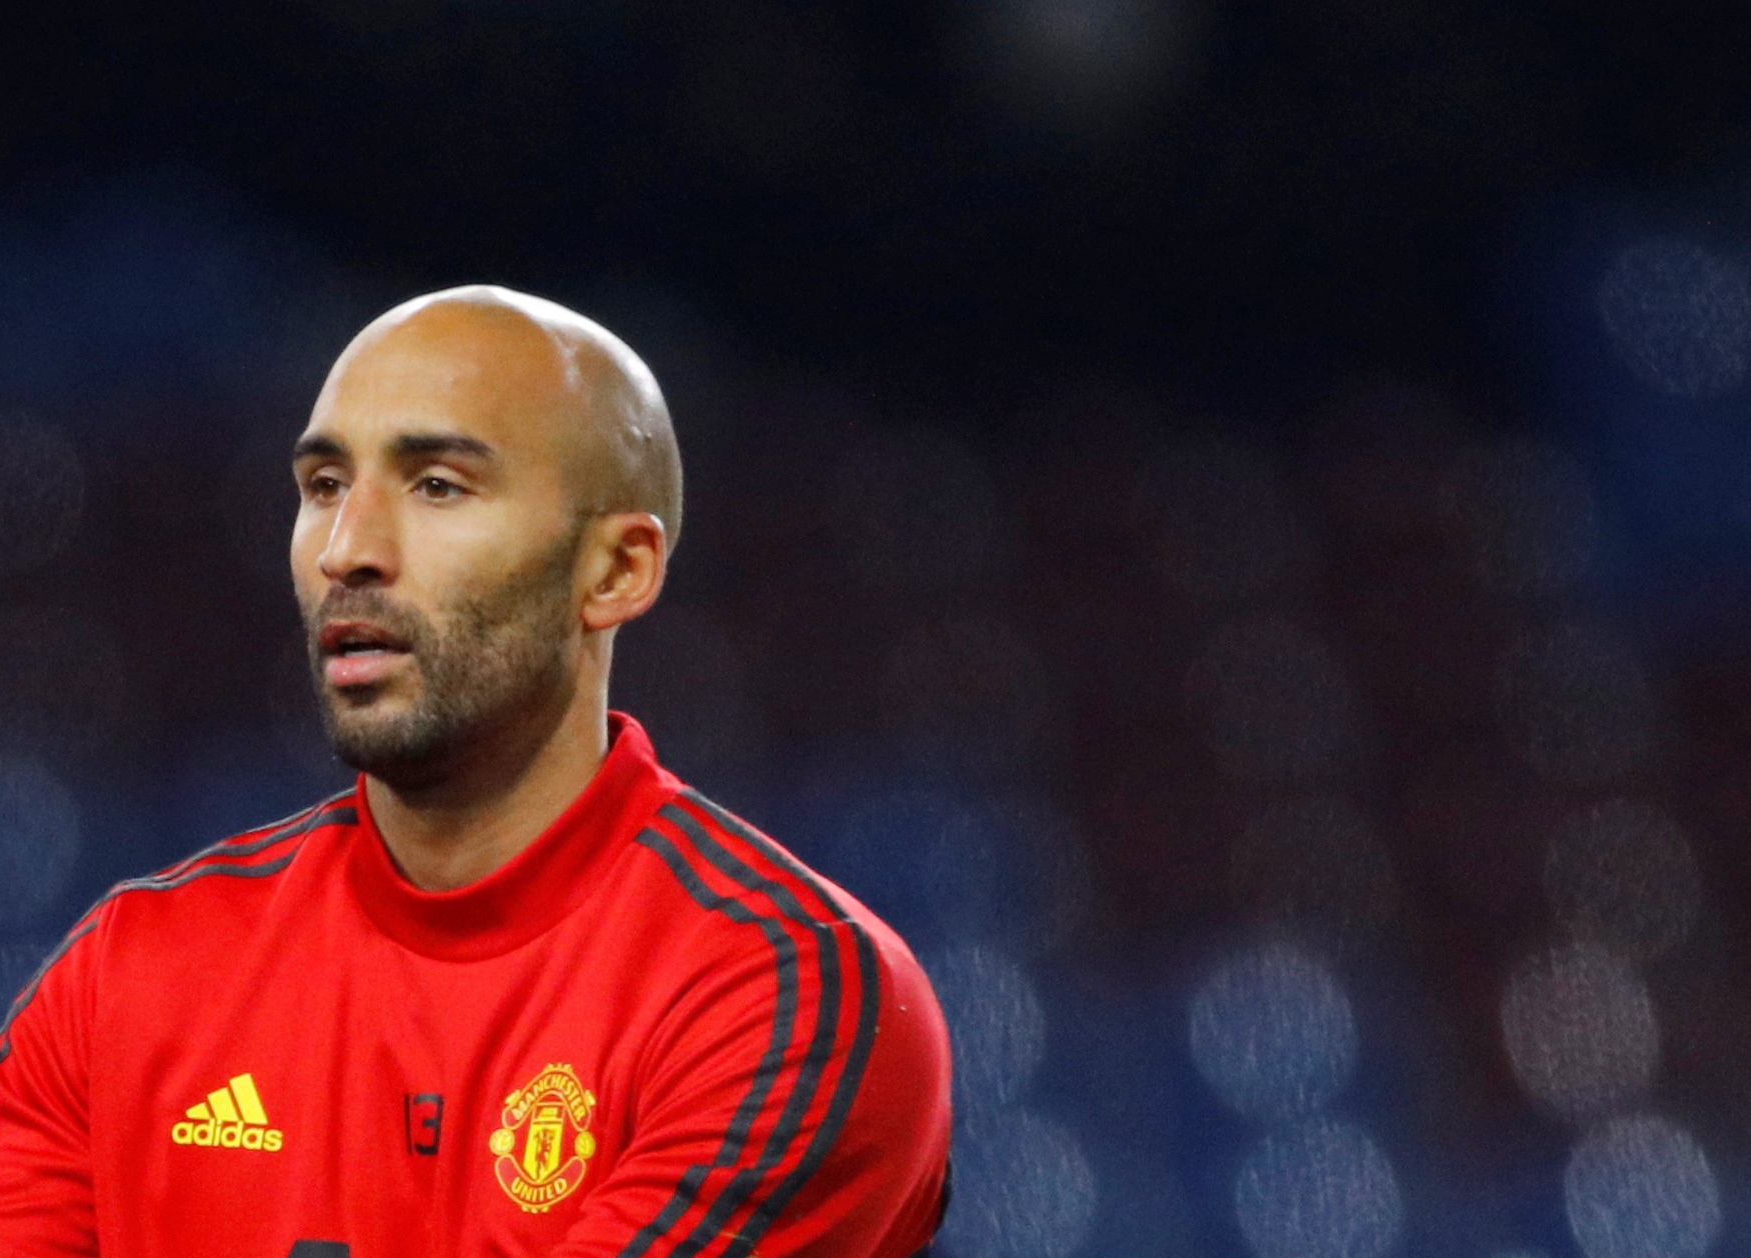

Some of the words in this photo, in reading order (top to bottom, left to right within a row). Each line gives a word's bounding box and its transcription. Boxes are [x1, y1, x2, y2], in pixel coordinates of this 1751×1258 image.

[512, 1073, 586, 1121] MANCHESTER
[171, 1118, 284, 1152] adidas
[511, 1178, 568, 1201] UNITED
